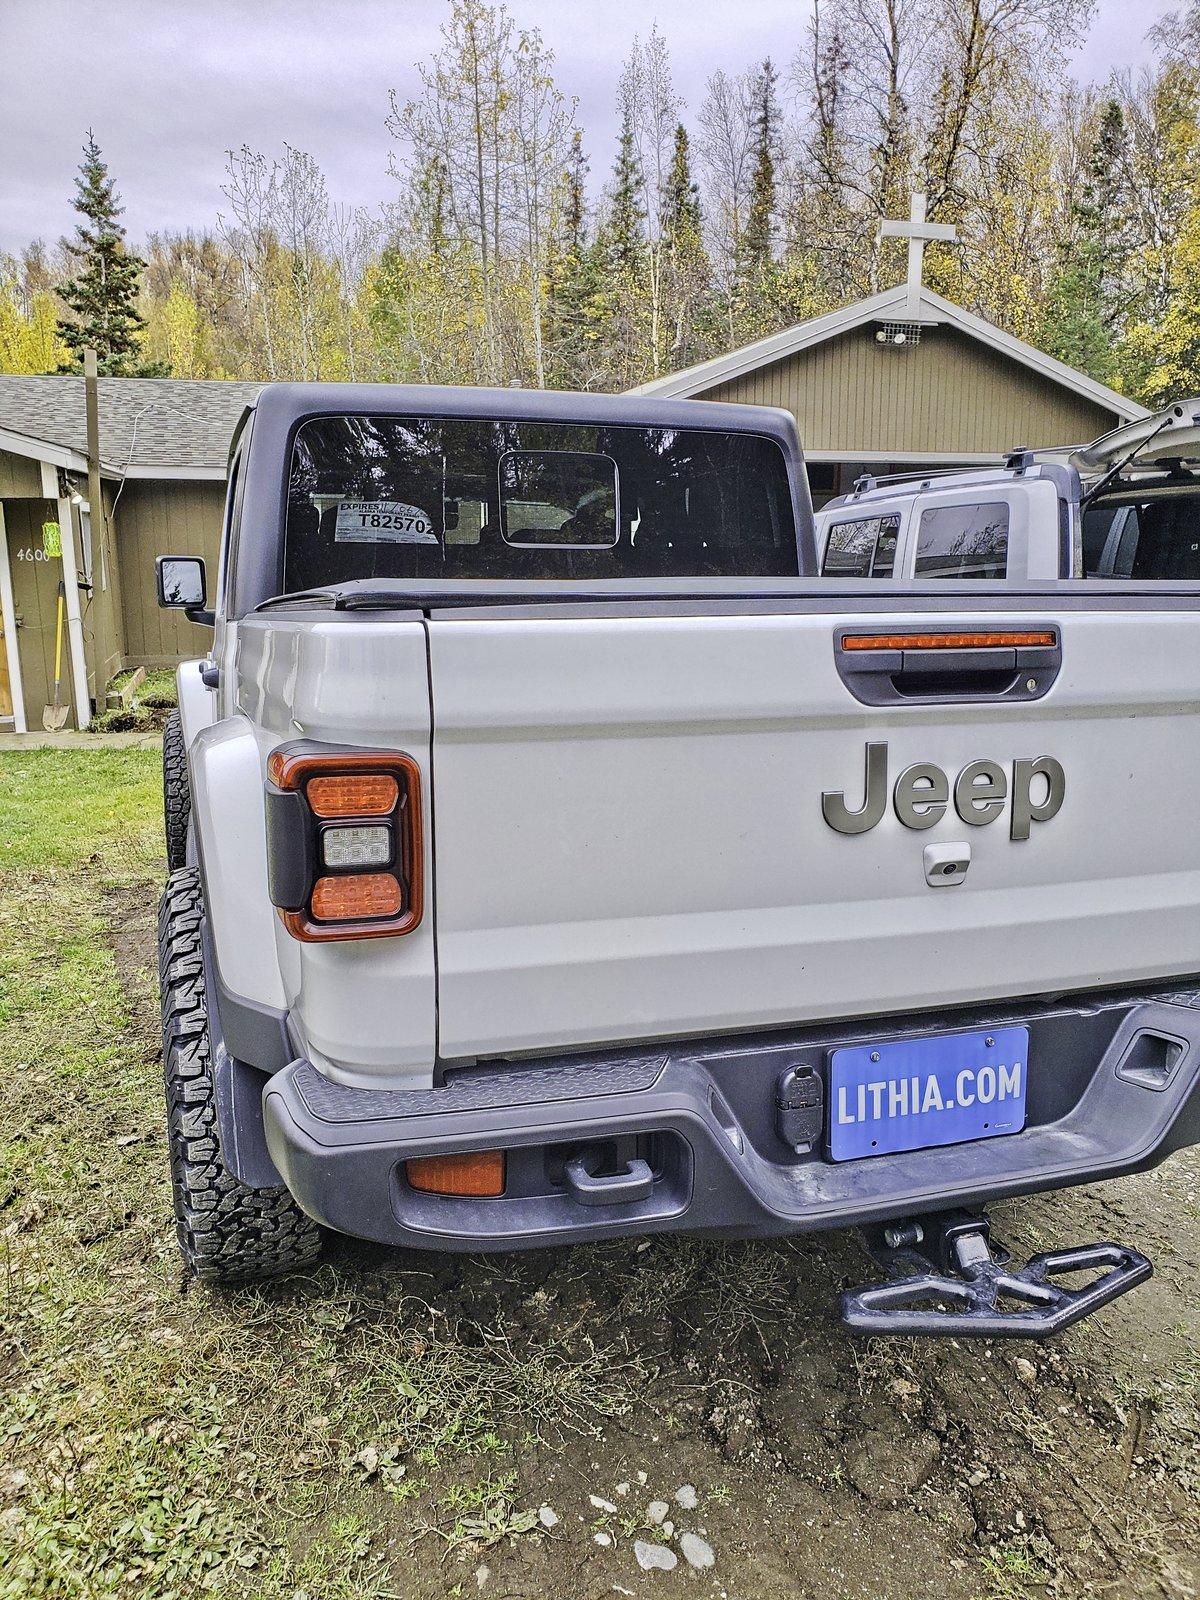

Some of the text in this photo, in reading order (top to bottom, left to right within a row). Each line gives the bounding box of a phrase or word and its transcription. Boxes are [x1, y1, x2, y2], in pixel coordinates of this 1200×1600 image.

[340, 503, 379, 511] EXPIRES
[821, 741, 1066, 840] Jeep
[838, 1062, 1022, 1125] LITHIA.COM
